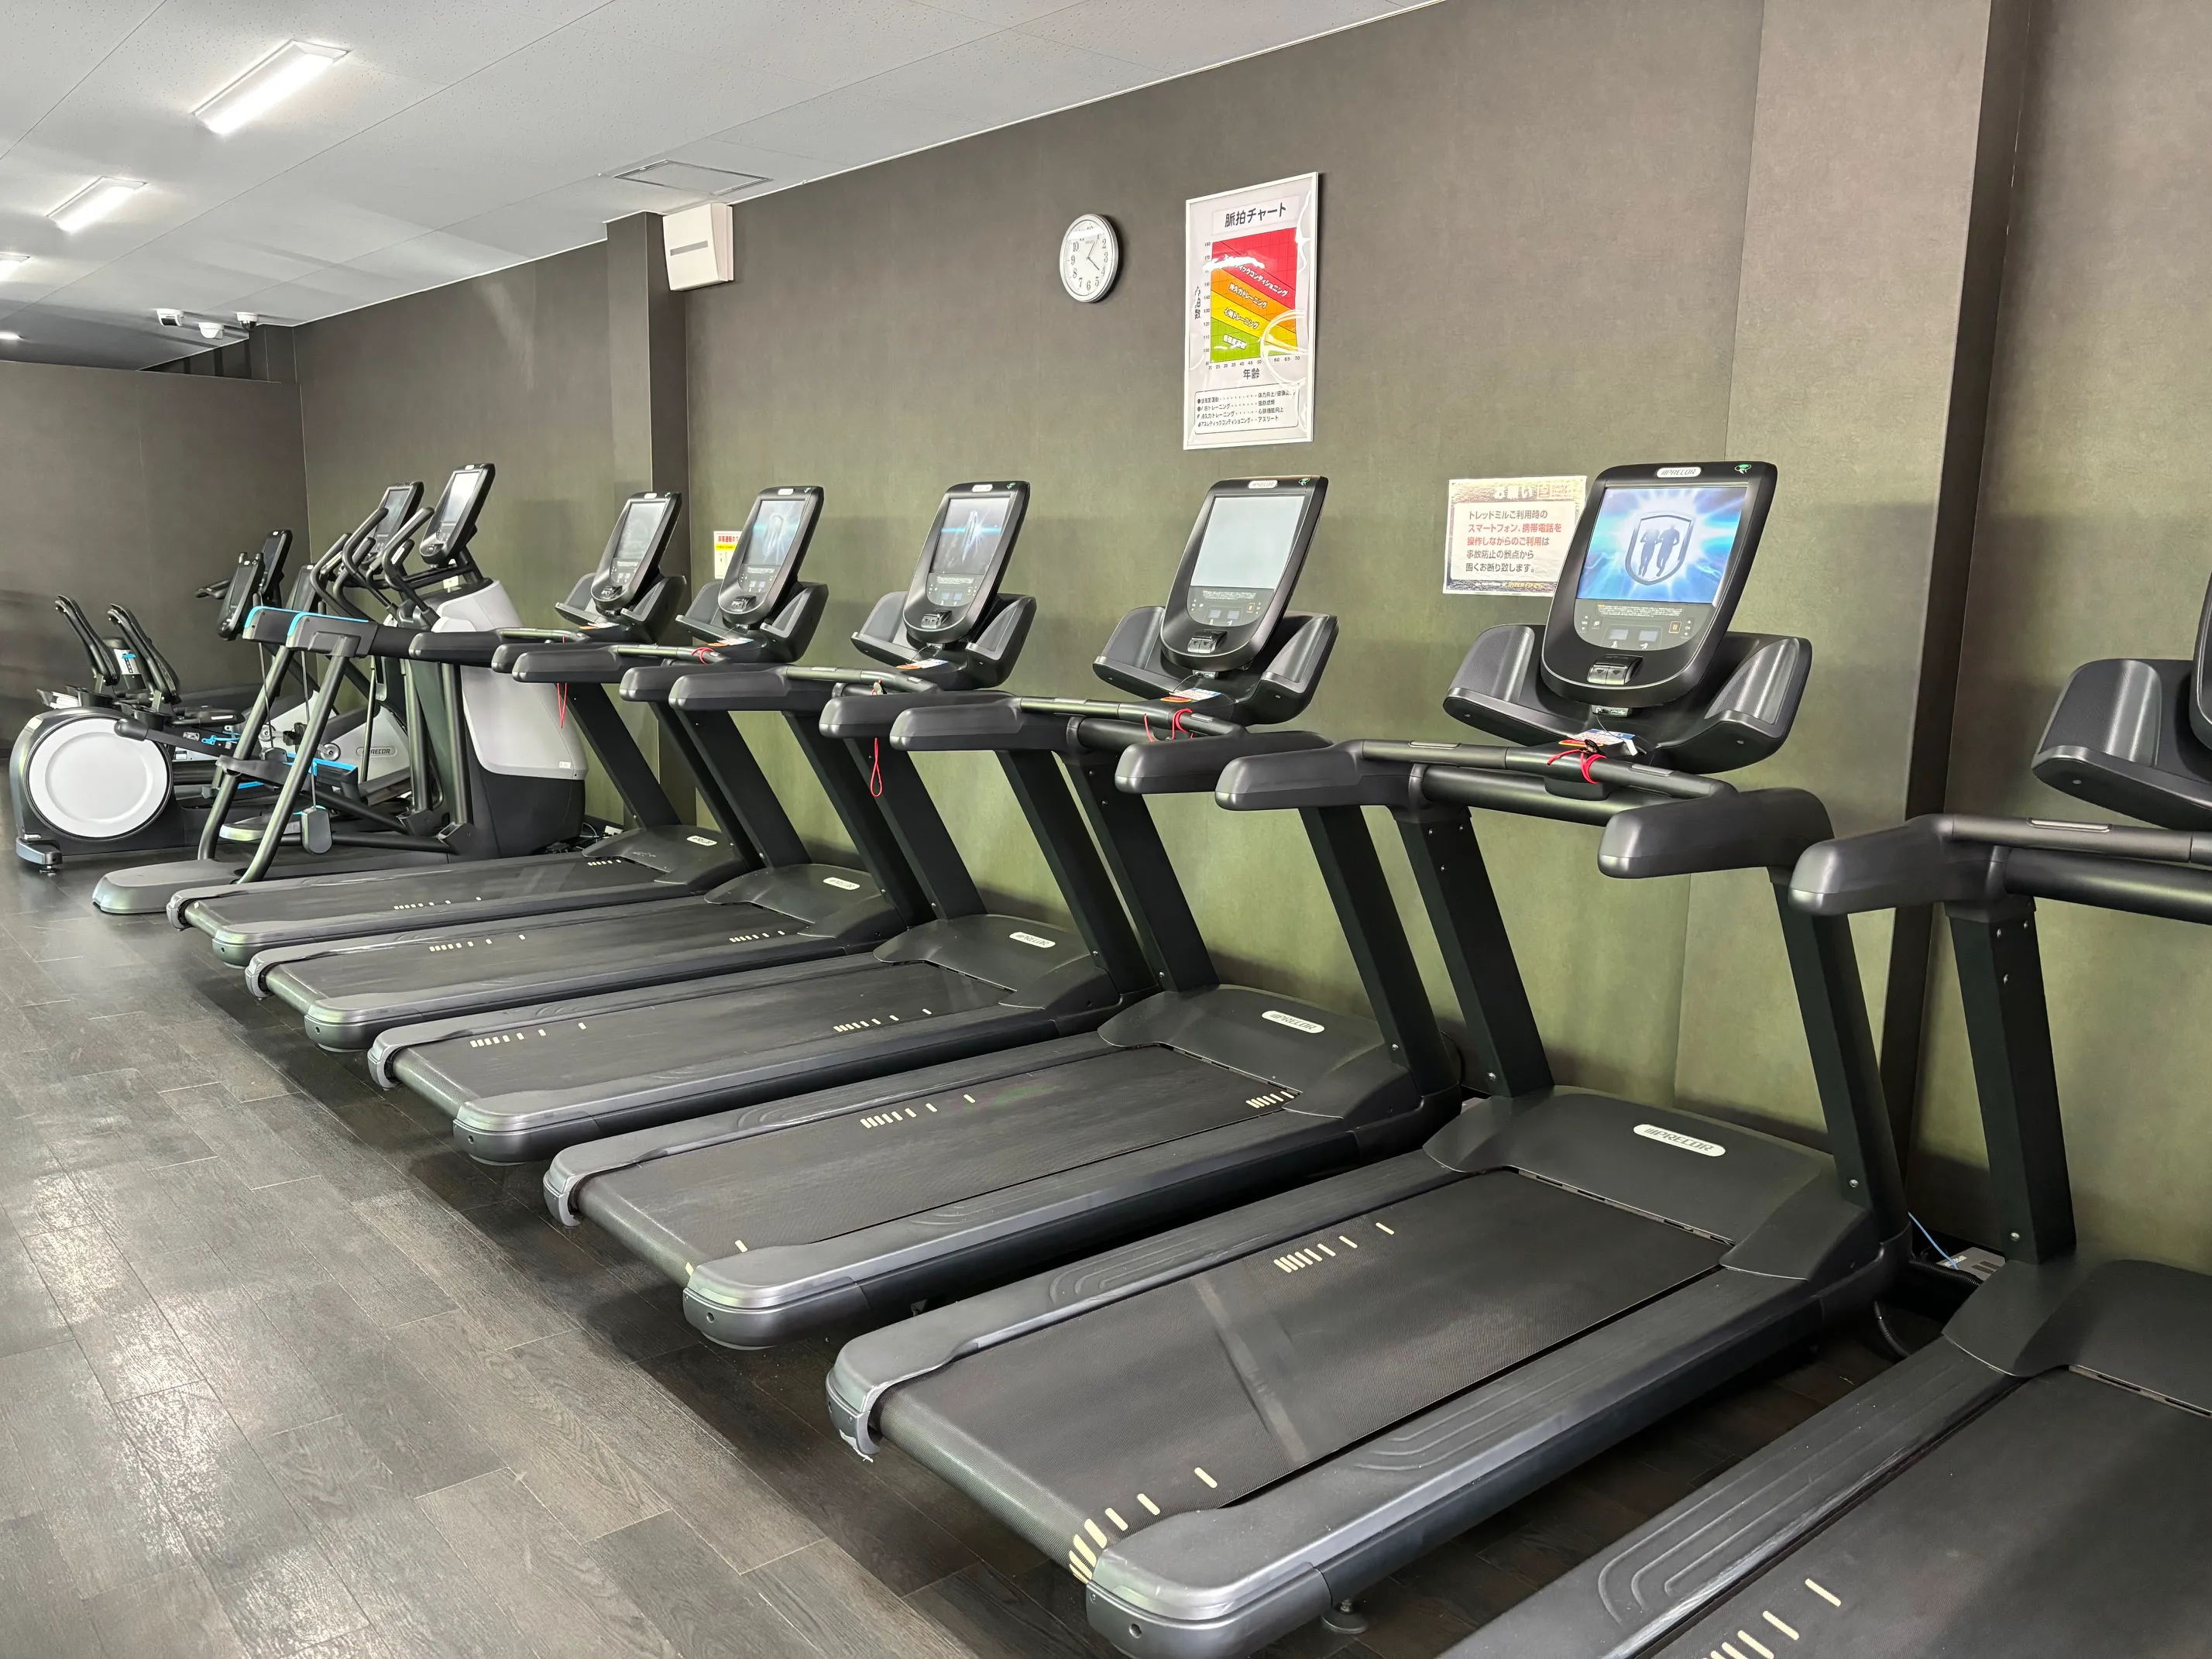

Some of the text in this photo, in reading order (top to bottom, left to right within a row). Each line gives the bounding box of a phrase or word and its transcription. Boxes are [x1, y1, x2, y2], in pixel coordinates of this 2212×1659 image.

[1224, 202, 1286, 228] 脈拍チャート
[1073, 242, 1079, 252] 10
[1102, 239, 1107, 249] 2
[1071, 255, 1075, 266] 9
[1104, 252, 1108, 263] 3
[1073, 268, 1077, 278] 8
[1079, 277, 1083, 288] 7
[1087, 280, 1091, 290] 6
[1095, 276, 1100, 287] 5
[1242, 368, 1260, 380] 年齢
[1469, 510, 1548, 520] トレッドミルご利用時の
[1468, 523, 1562, 533] スマートフォン、携帯電話を
[1467, 536, 1550, 546] 操作しながらのご利用は
[1466, 549, 1534, 559] 事故防止の観点から
[1465, 563, 1536, 573] 固くお断り致します。
[1275, 1014, 1317, 1030] PRECOR
[1650, 1130, 1715, 1152] PRECOR
